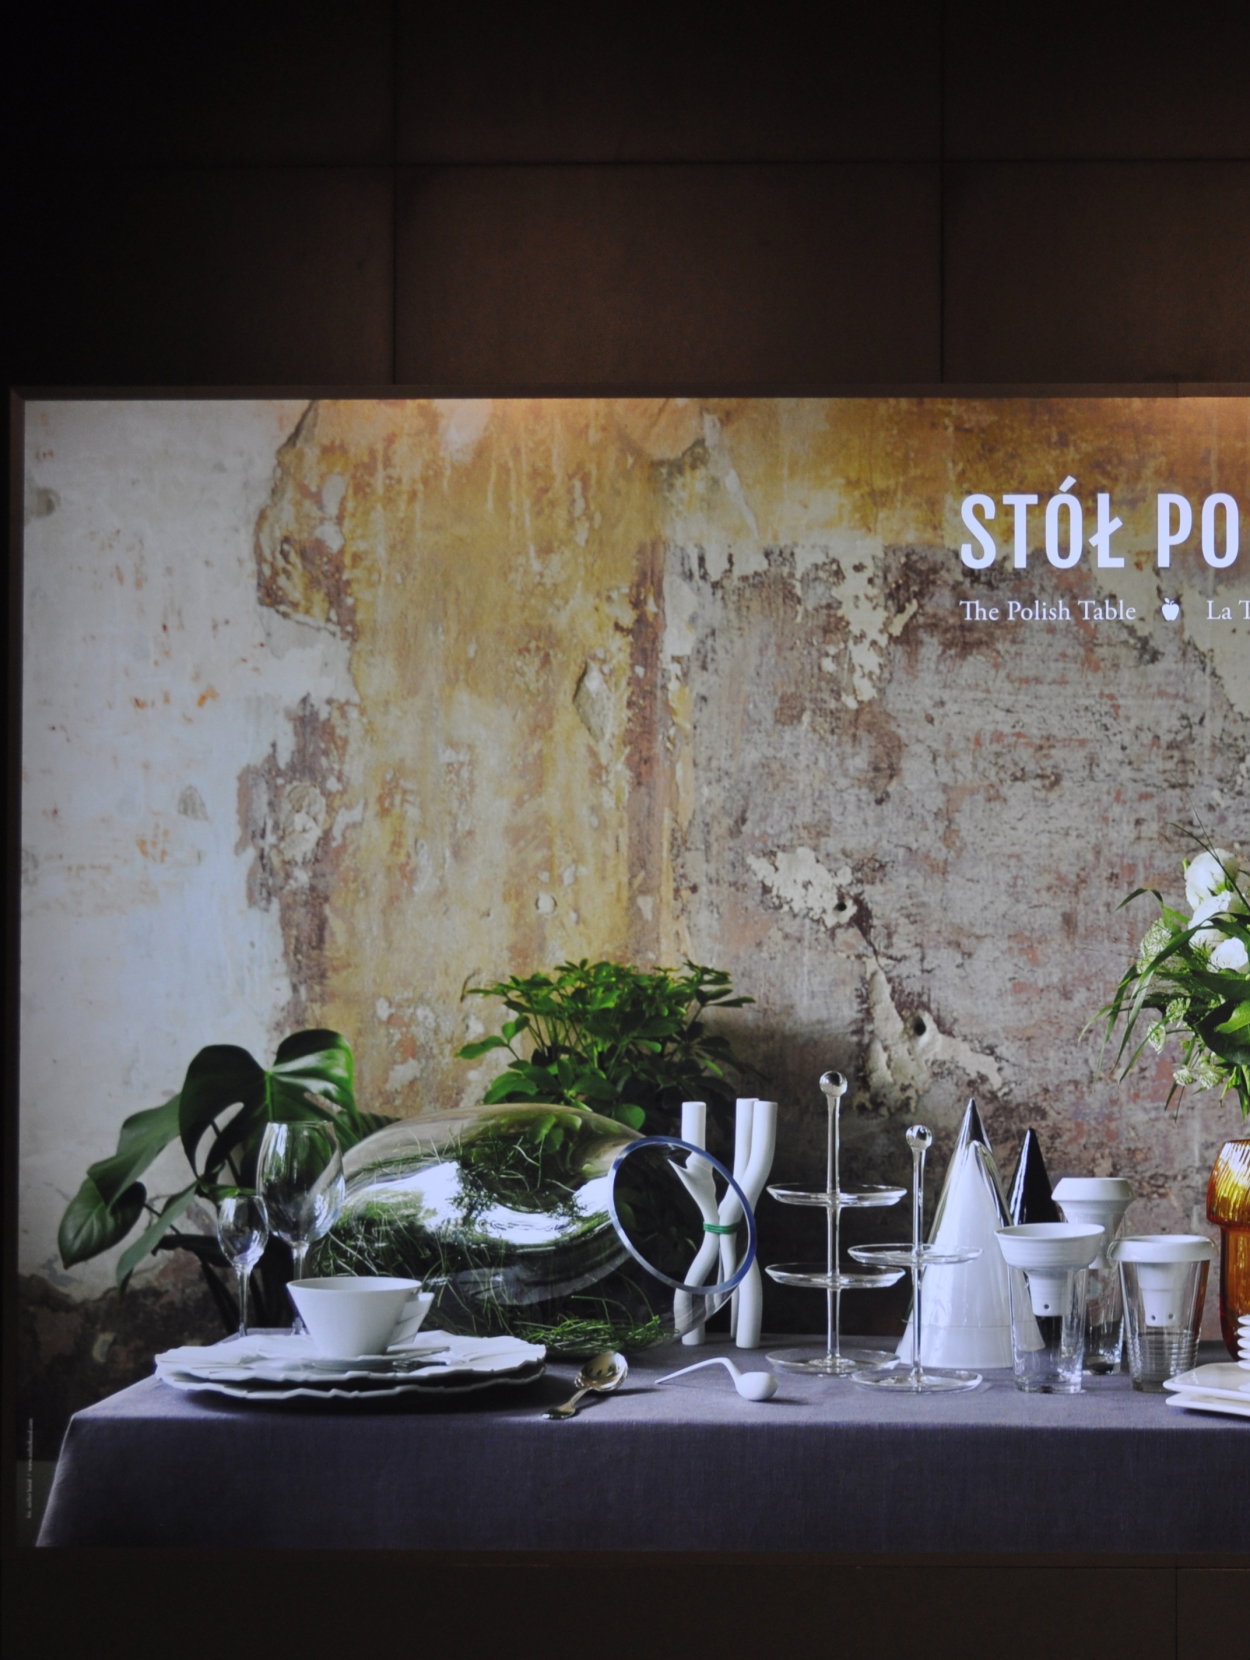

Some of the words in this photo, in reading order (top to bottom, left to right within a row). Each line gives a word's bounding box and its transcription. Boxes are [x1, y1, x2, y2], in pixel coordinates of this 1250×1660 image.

[959, 475, 1126, 570] STÓŁ
[960, 599, 999, 622] The
[1006, 599, 1072, 622] Polish
[1077, 599, 1137, 622] Table
[1205, 599, 1233, 621] La
